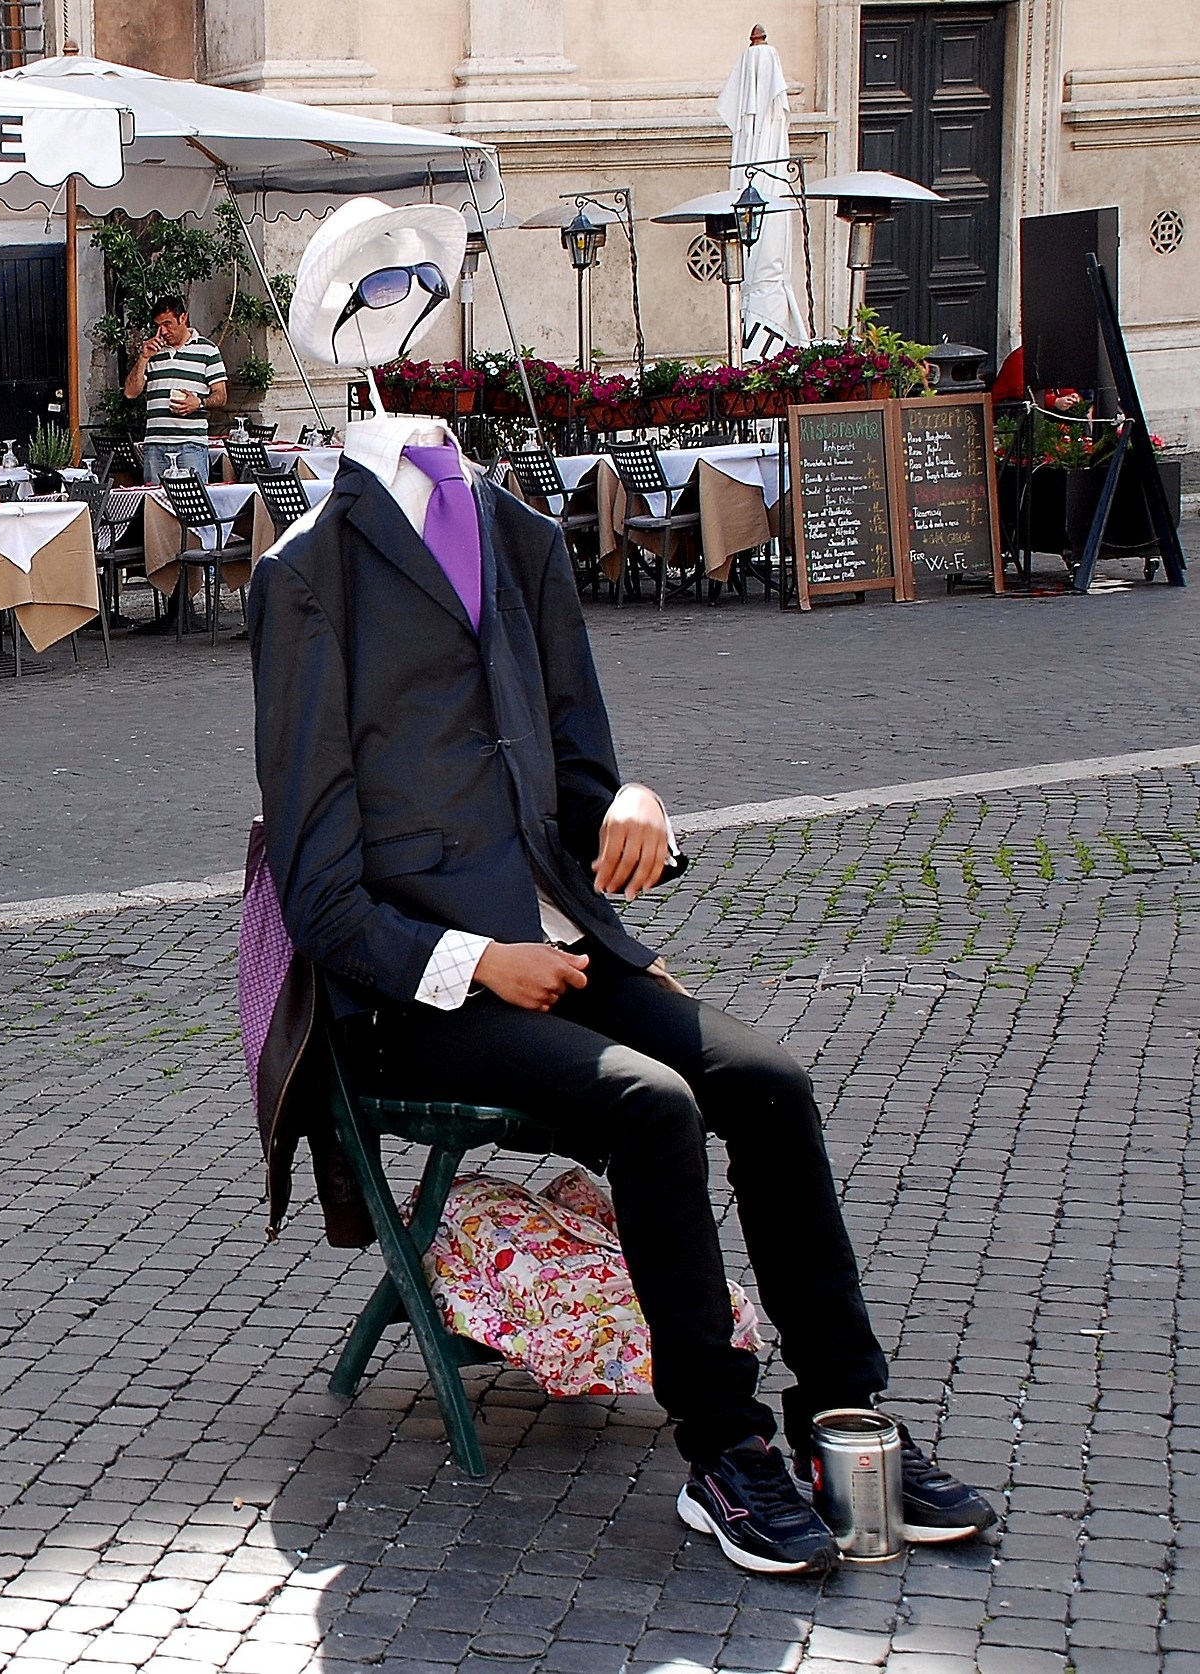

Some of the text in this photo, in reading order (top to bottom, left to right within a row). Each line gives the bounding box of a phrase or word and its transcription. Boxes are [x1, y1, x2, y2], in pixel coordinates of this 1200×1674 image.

[799, 414, 879, 441] Ristorante
[909, 549, 925, 562] Free
[925, 552, 968, 571] Wi-Fi
